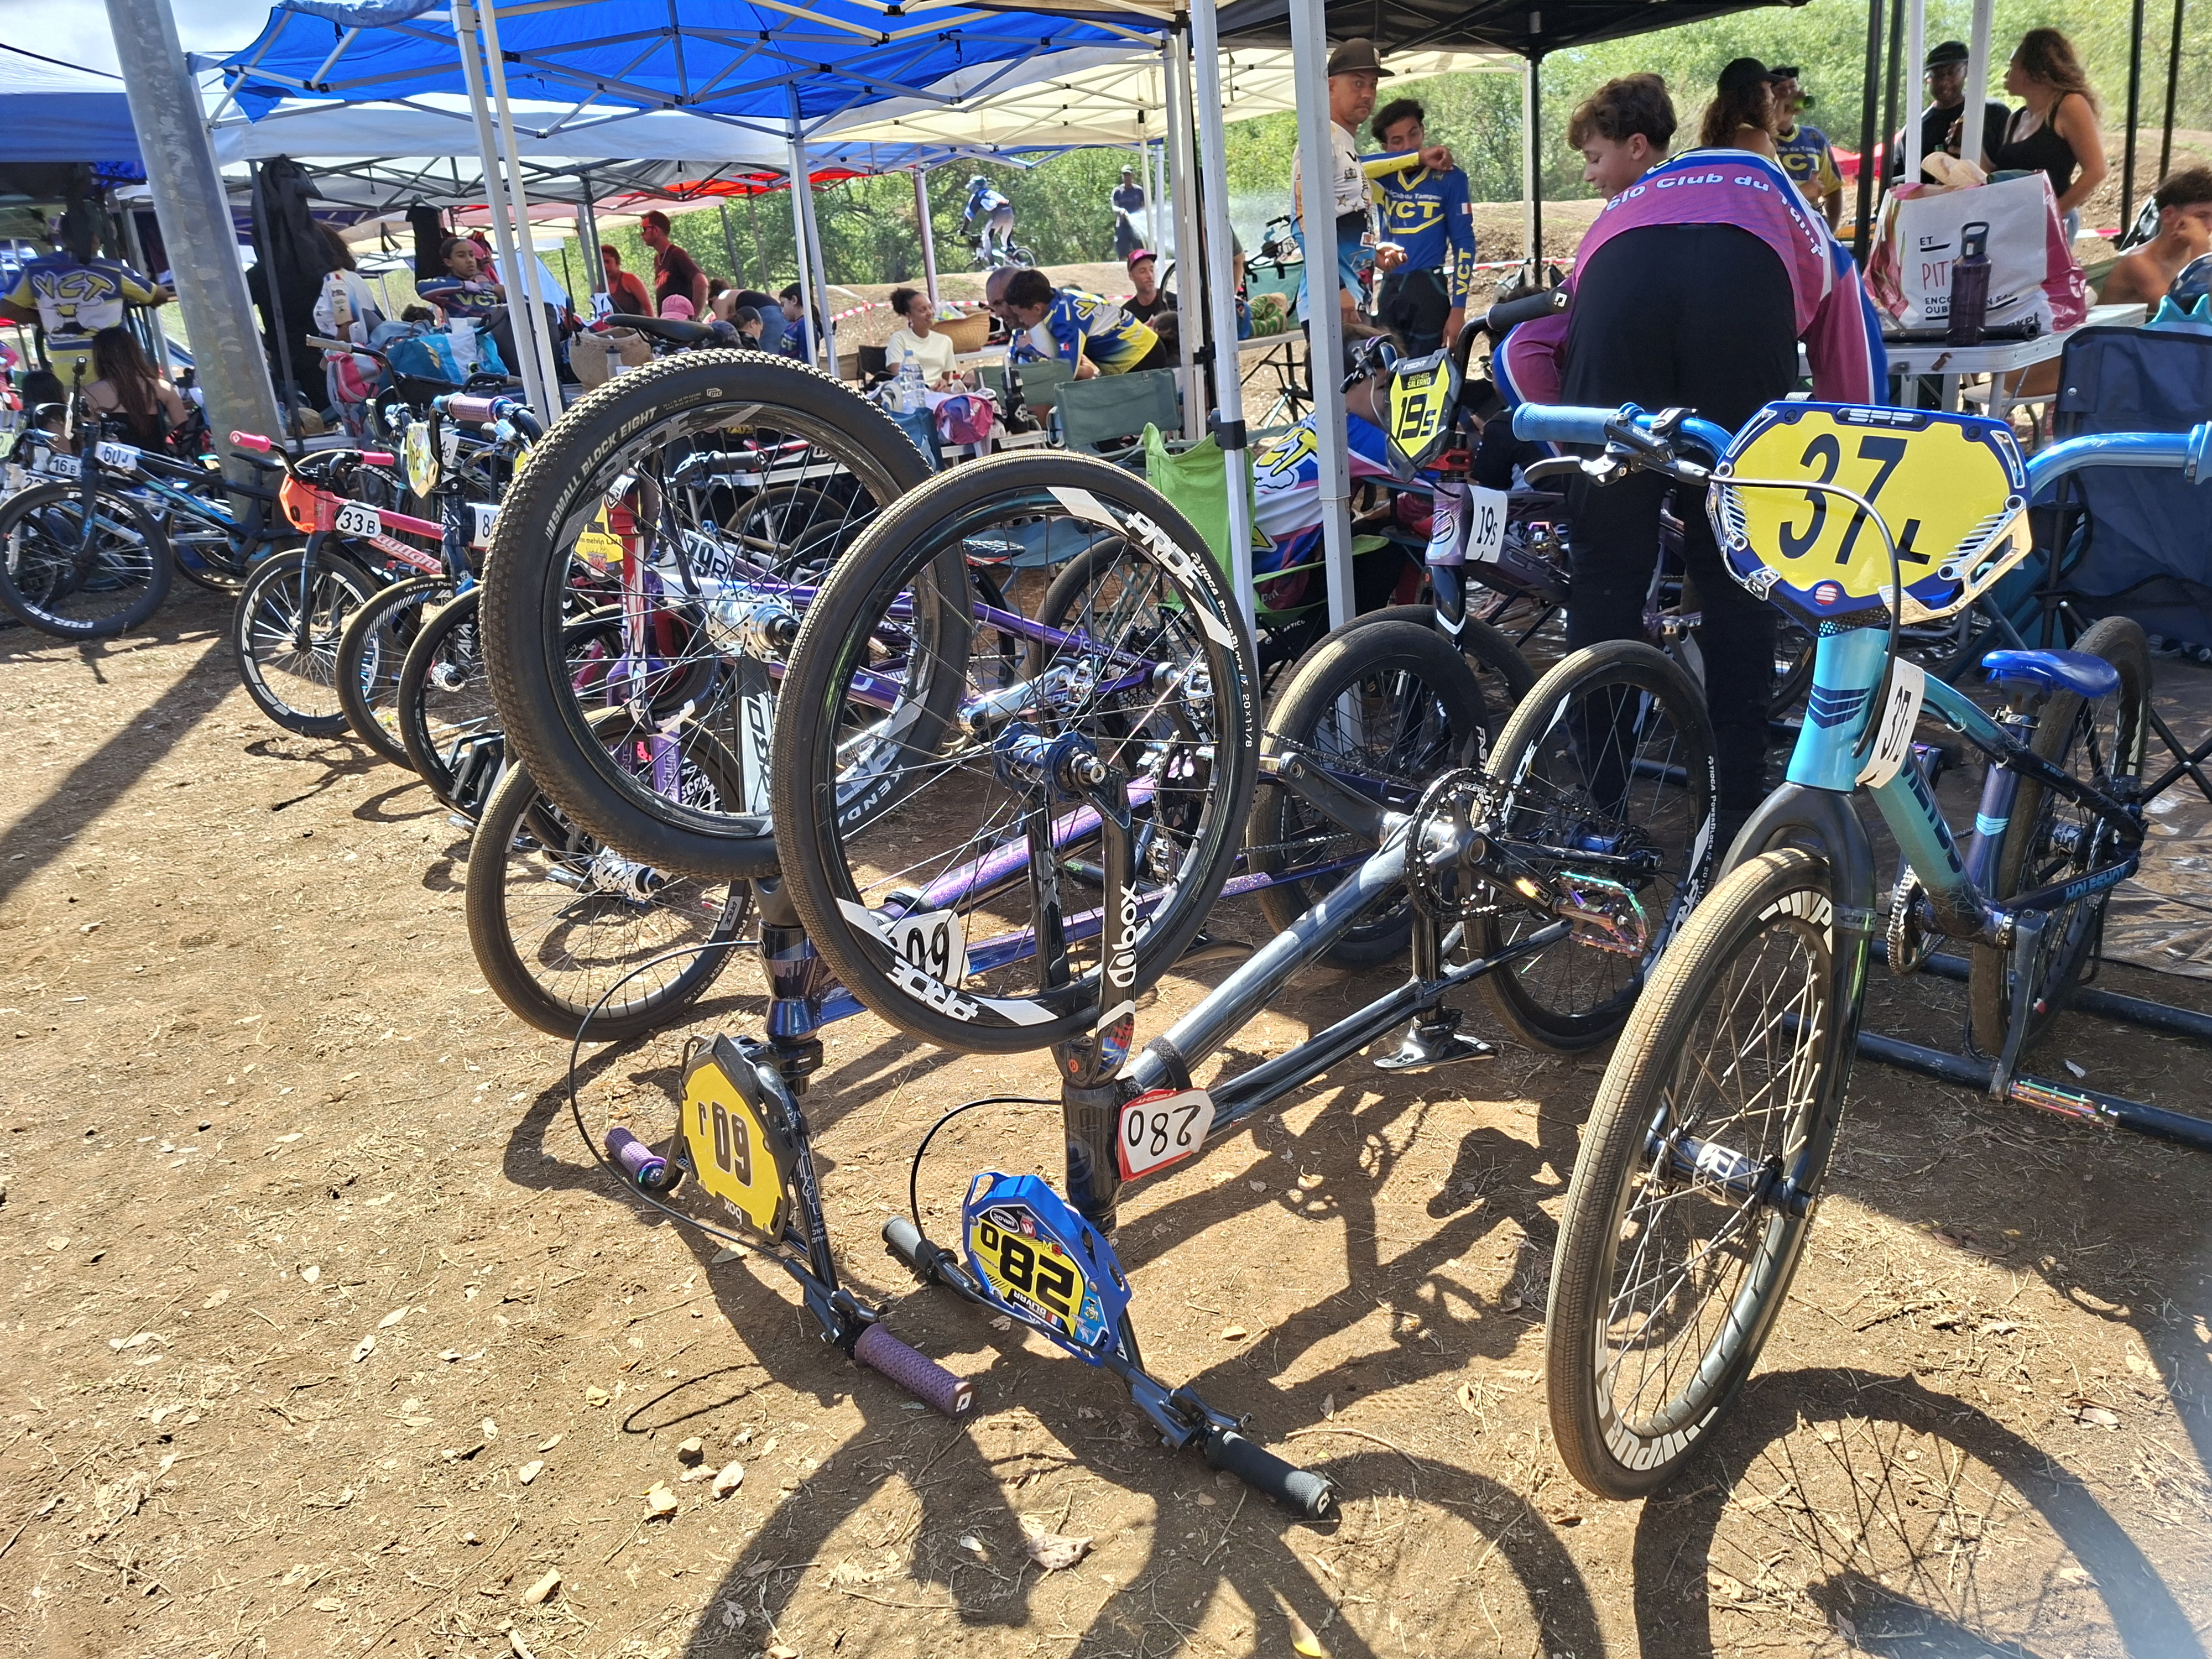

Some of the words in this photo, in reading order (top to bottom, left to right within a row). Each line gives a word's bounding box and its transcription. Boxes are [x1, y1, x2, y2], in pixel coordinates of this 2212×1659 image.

[1782, 153, 1819, 171] CT
[1656, 173, 1724, 189] Club
[1733, 175, 1770, 192] du
[1384, 196, 1441, 218] VCT
[1919, 236, 1934, 246] ET
[1455, 247, 1472, 295] VCT
[1921, 259, 1955, 291] PIT
[33, 271, 114, 301] VCT
[455, 293, 498, 306] VCT
[1924, 295, 1951, 305] ENC
[1925, 305, 1949, 314] OUB
[780, 337, 796, 351] CT
[1407, 377, 1432, 389] SALERNO
[552, 474, 582, 526] SMALL
[580, 430, 618, 476] BLOCK
[619, 405, 658, 439] EIGHT
[340, 511, 376, 535] 33B
[586, 538, 605, 547] melvin
[1124, 511, 1203, 591] PRIDE
[1197, 563, 1220, 597] TIOGA
[1044, 692, 1070, 707] SPR
[1474, 724, 1489, 773] FAST
[2065, 864, 2127, 901] HOLESHOT
[1112, 881, 1136, 951] box
[889, 922, 950, 983] 60
[723, 1197, 743, 1225] box
[1013, 1290, 1047, 1319] OLIVAR
